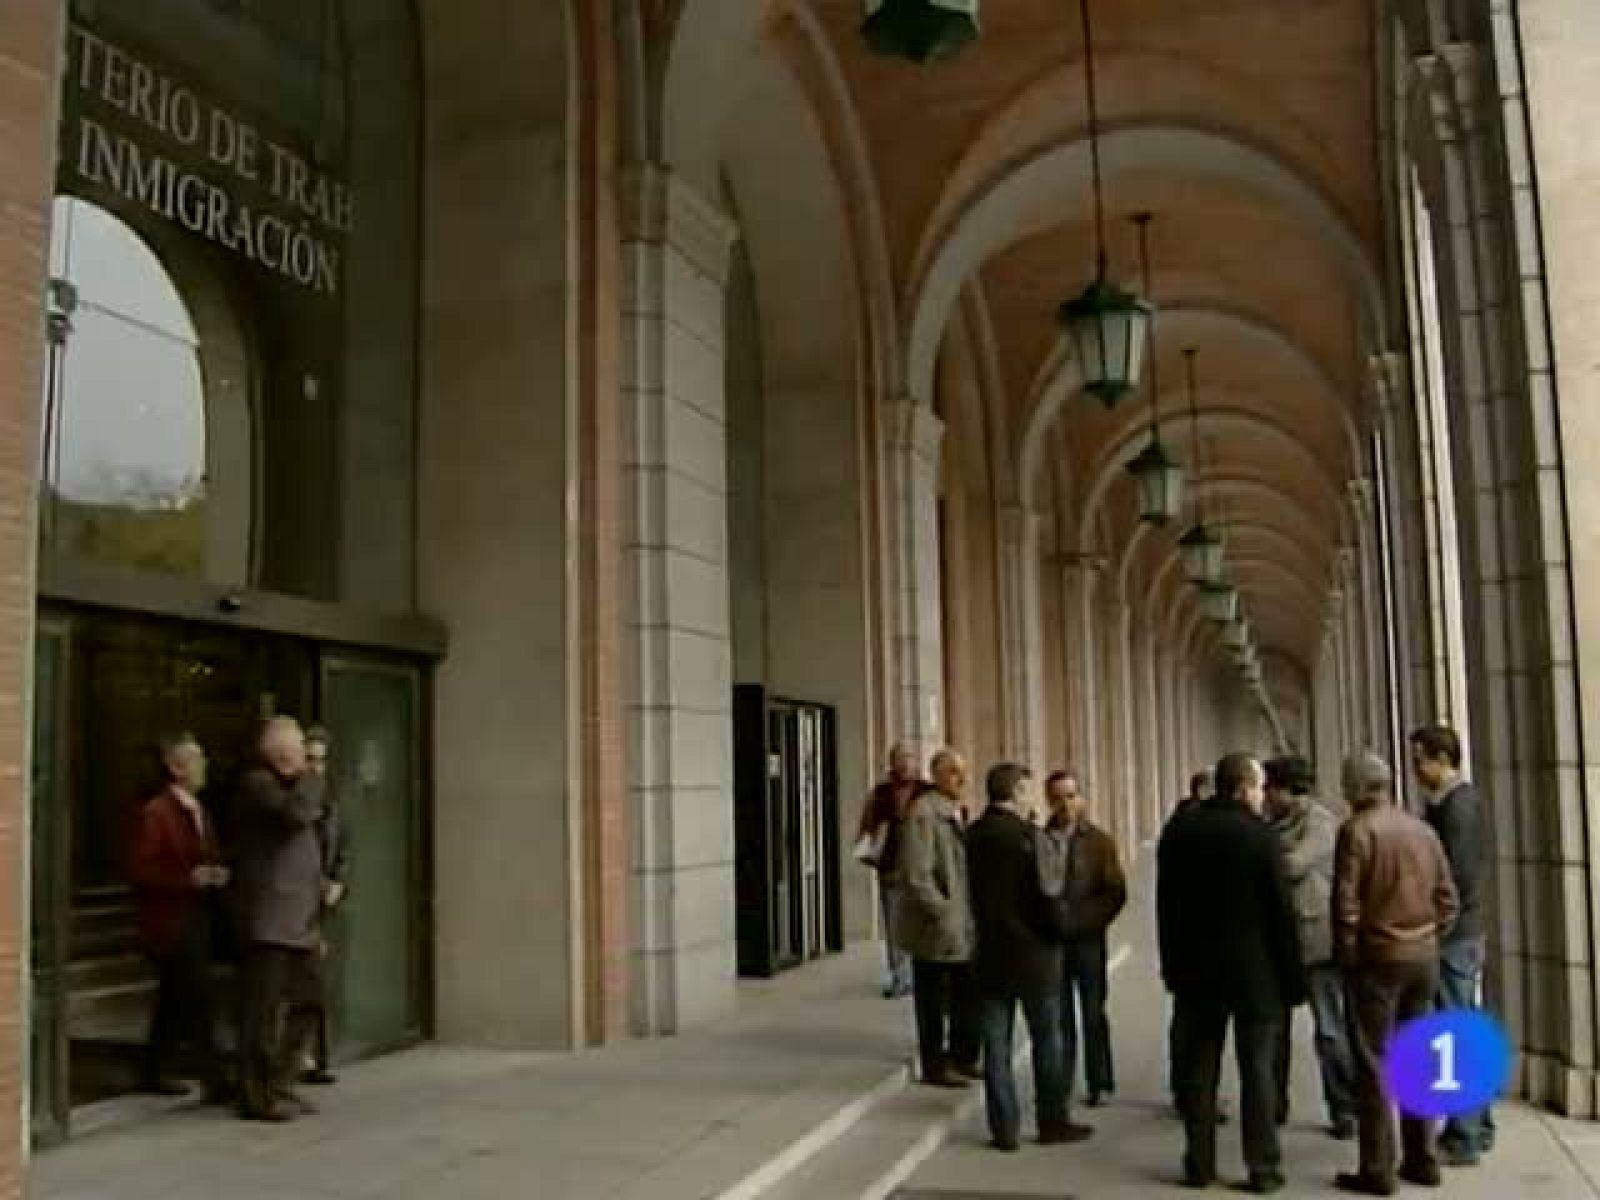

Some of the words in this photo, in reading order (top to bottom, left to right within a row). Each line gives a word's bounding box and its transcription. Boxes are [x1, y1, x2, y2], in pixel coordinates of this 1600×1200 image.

[74, 27, 199, 143] TERIO
[208, 108, 257, 181] DE
[78, 116, 338, 293] INMIGRACIÓN
